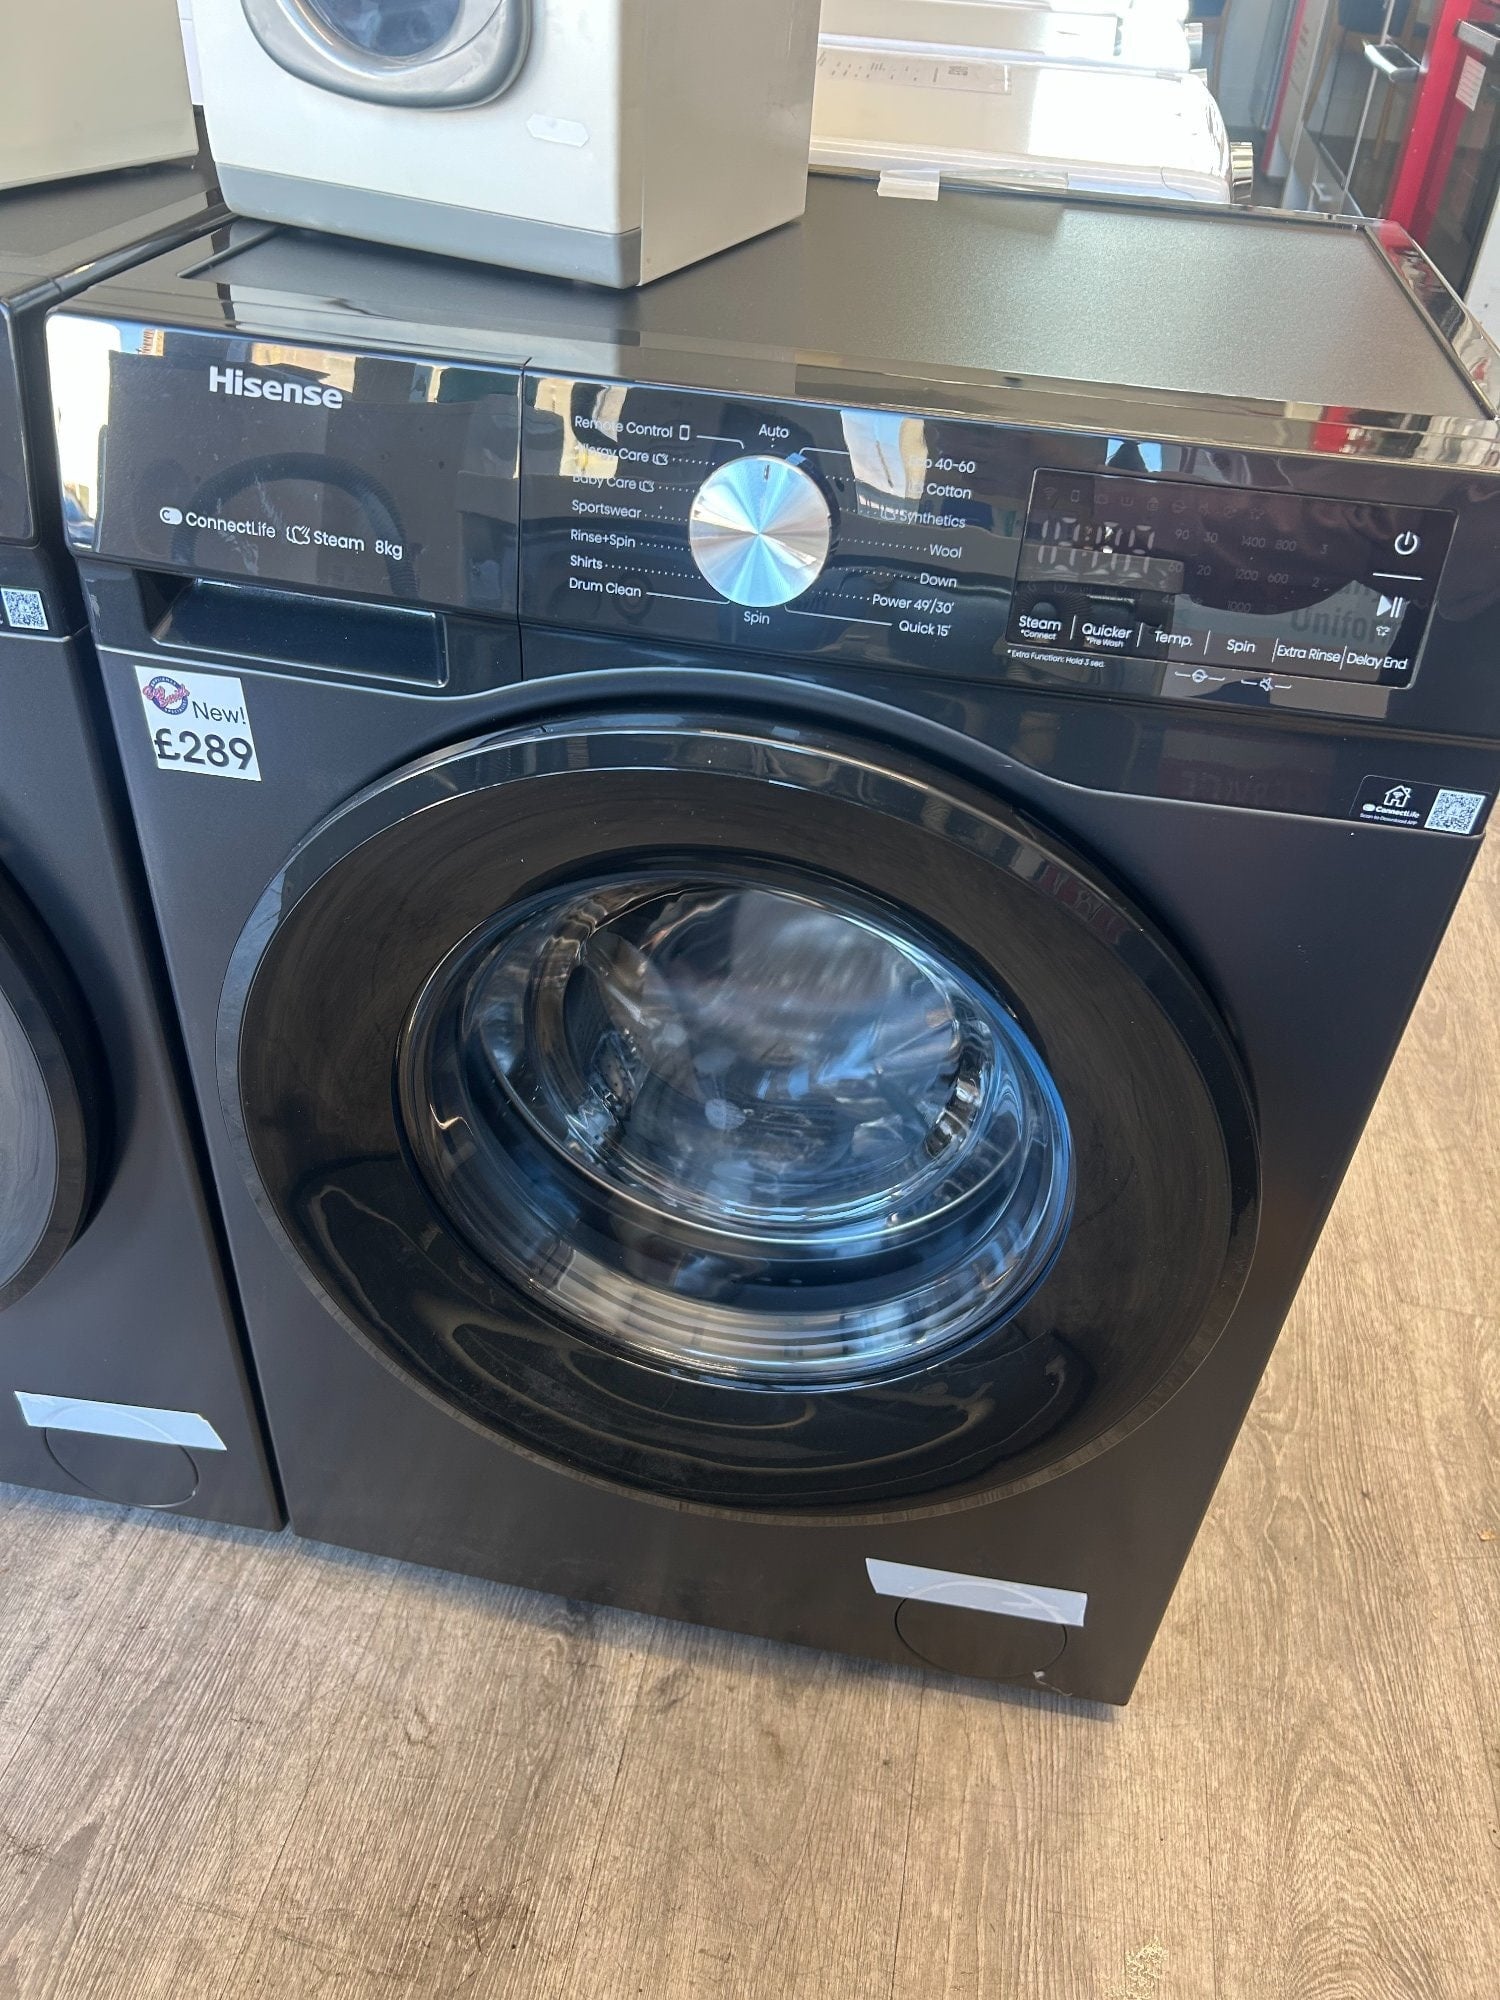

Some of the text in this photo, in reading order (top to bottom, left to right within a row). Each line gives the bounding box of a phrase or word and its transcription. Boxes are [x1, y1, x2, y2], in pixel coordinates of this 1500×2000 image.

[209, 365, 344, 409] Hisense
[574, 415, 674, 439] Remote Control
[758, 423, 790, 439] Auto
[618, 447, 650, 463] Care
[934, 457, 976, 474] 40-60
[606, 475, 637, 490] Care
[926, 482, 972, 500] Cotton
[571, 499, 642, 519] Sportswear
[185, 511, 276, 539] ConnectLife
[899, 509, 967, 529] Synthetics
[313, 530, 365, 551] Steam
[570, 528, 637, 550] Rinse+Spin
[374, 540, 403, 561] 8kg
[929, 543, 962, 559] Wool
[570, 554, 603, 570] Shirts
[569, 577, 642, 598] Drum Clean
[919, 572, 958, 588] Down
[872, 593, 912, 609] Power
[743, 610, 770, 626] Spin
[1018, 614, 1062, 632] Steam
[898, 619, 936, 636] Quick
[1081, 622, 1133, 640] Quicker
[1102, 638, 1124, 648] Wash
[1154, 630, 1194, 647] Temp.
[1226, 638, 1255, 654] Spin
[1065, 656, 1083, 666] Hold
[1276, 644, 1341, 664] Extra Rinse
[1346, 652, 1408, 671] Delay End
[191, 700, 247, 725] New!
[153, 727, 254, 771] £289
[1375, 805, 1420, 819] ConnectLife
